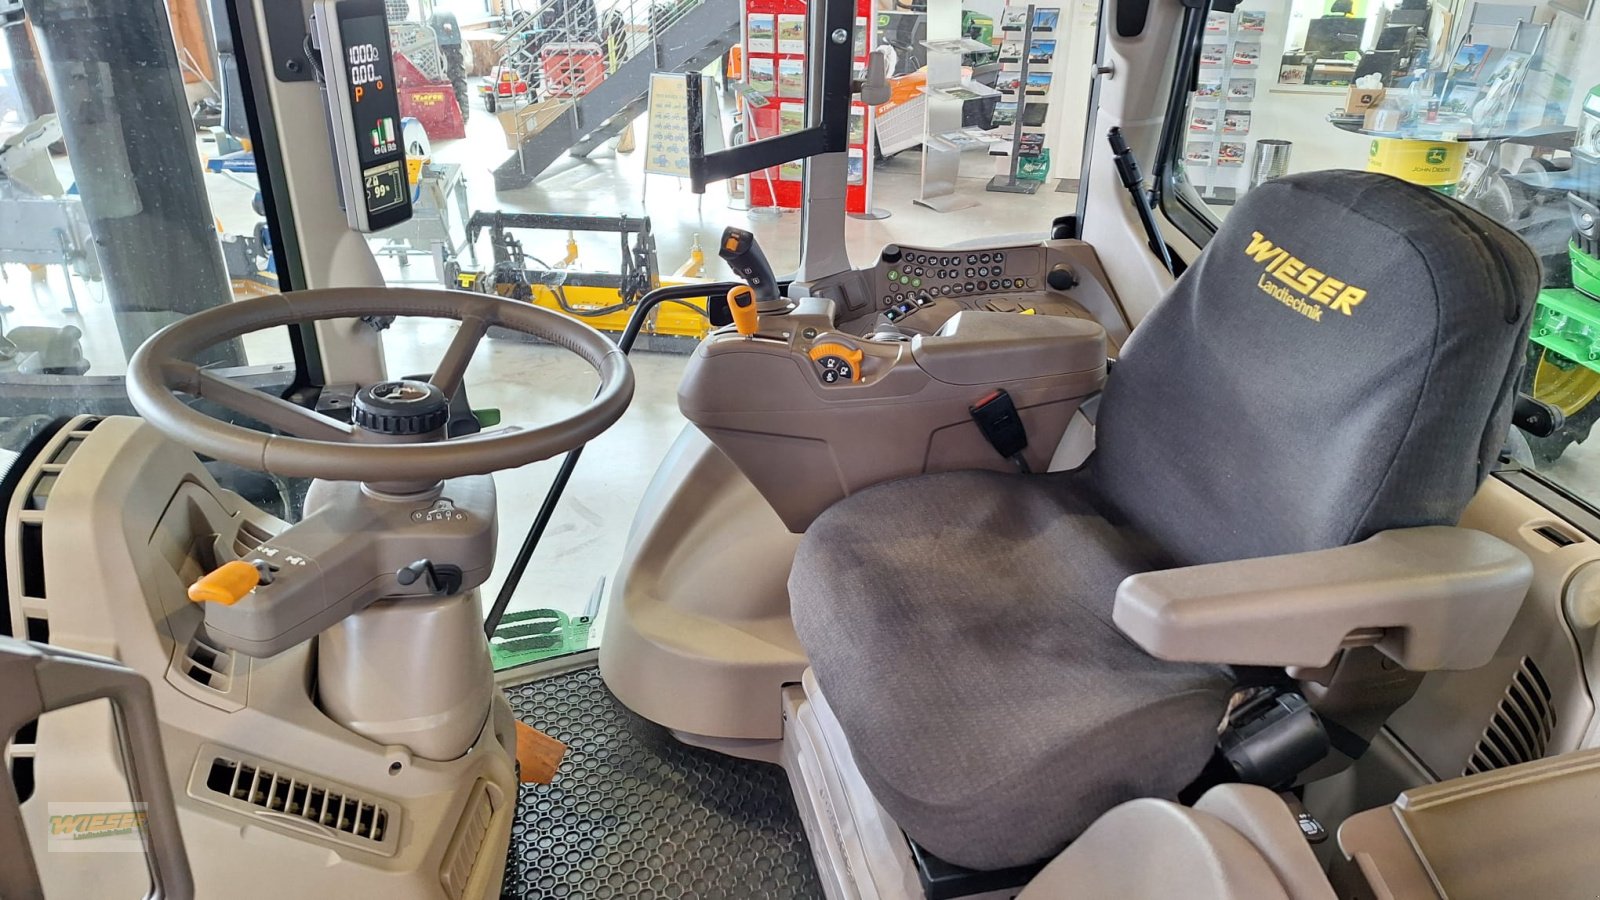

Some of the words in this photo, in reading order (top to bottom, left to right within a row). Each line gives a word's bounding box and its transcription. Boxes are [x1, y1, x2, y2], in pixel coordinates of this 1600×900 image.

[350, 44, 373, 64] 1000
[355, 86, 363, 103] P
[1245, 231, 1367, 315] WIESER
[1257, 272, 1324, 322] Landtechnik
